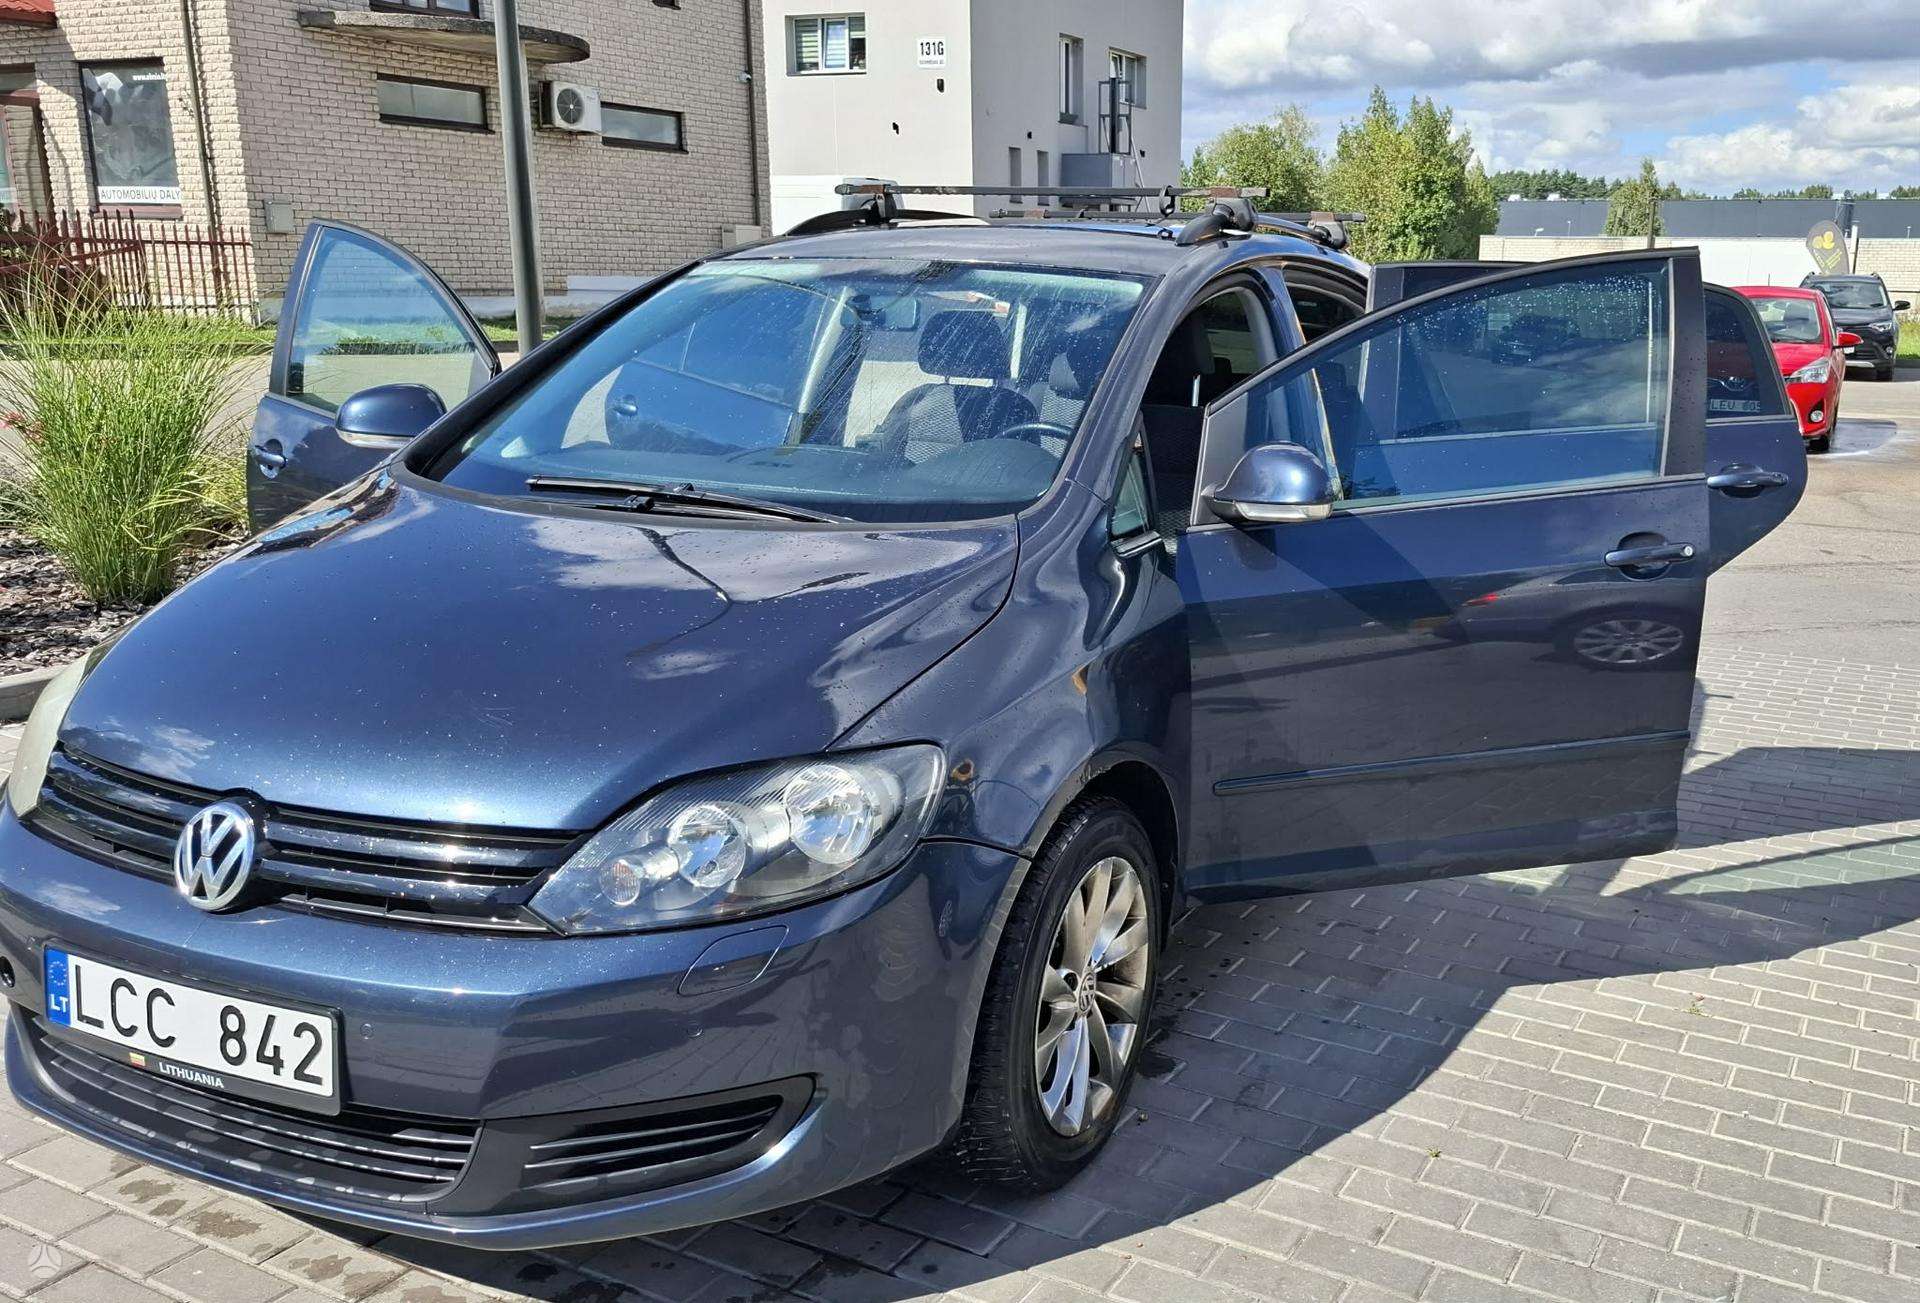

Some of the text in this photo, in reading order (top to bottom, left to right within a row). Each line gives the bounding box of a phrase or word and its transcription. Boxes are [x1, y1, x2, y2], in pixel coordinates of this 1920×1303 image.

[920, 41, 944, 56] 131G
[50, 993, 69, 1013] LT
[75, 964, 323, 1086] LCC 842
[159, 1061, 225, 1089] LITHUANIA
